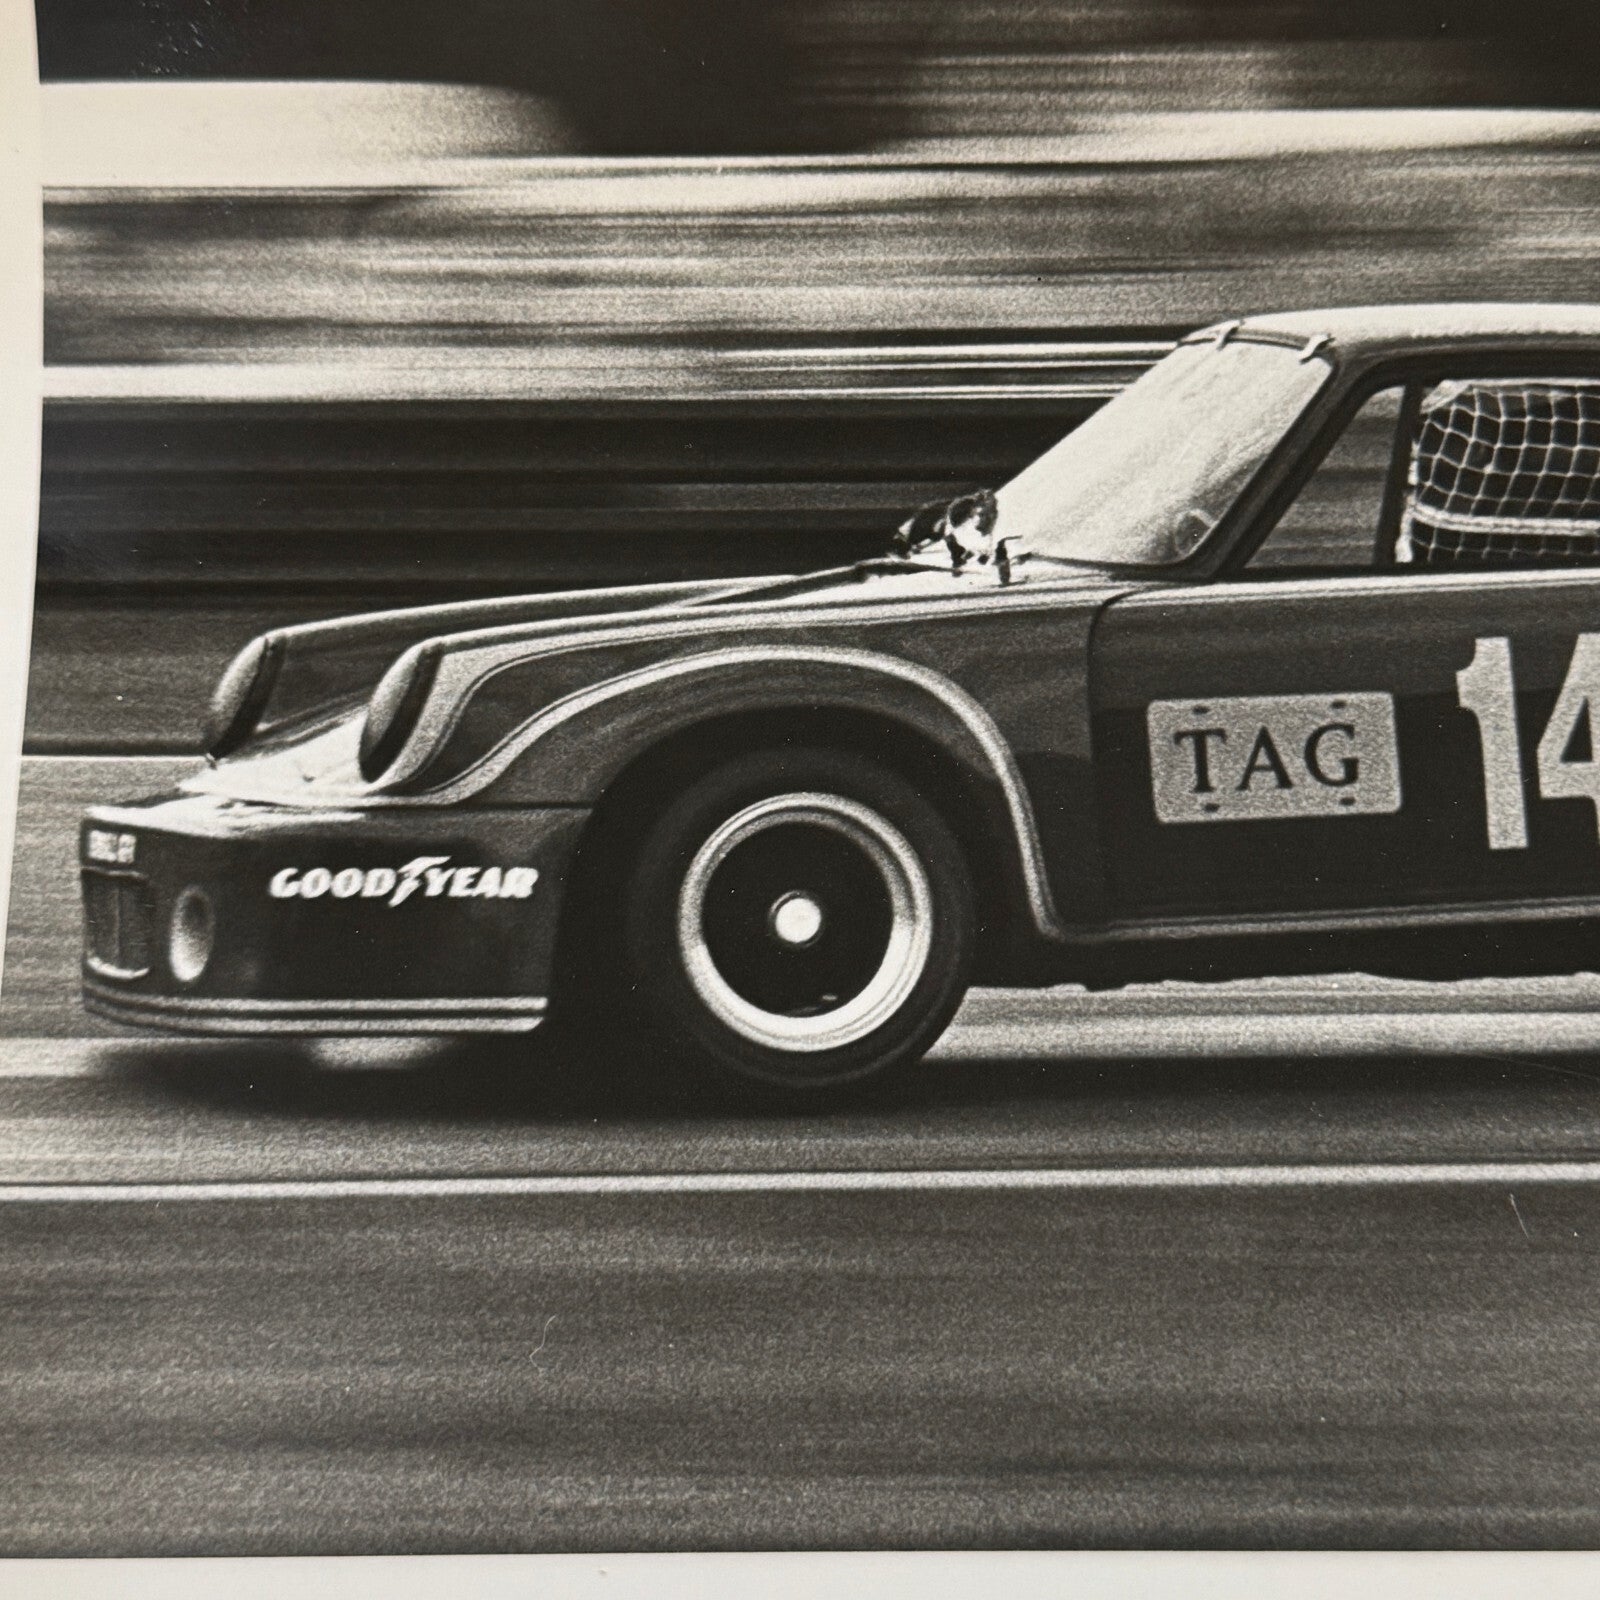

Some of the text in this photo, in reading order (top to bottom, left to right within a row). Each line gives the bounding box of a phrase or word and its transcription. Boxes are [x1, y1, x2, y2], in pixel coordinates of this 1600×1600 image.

[1173, 723, 1360, 793] TAG
[1455, 632, 1600, 849] 14
[269, 856, 539, 907] GOODYEAR
